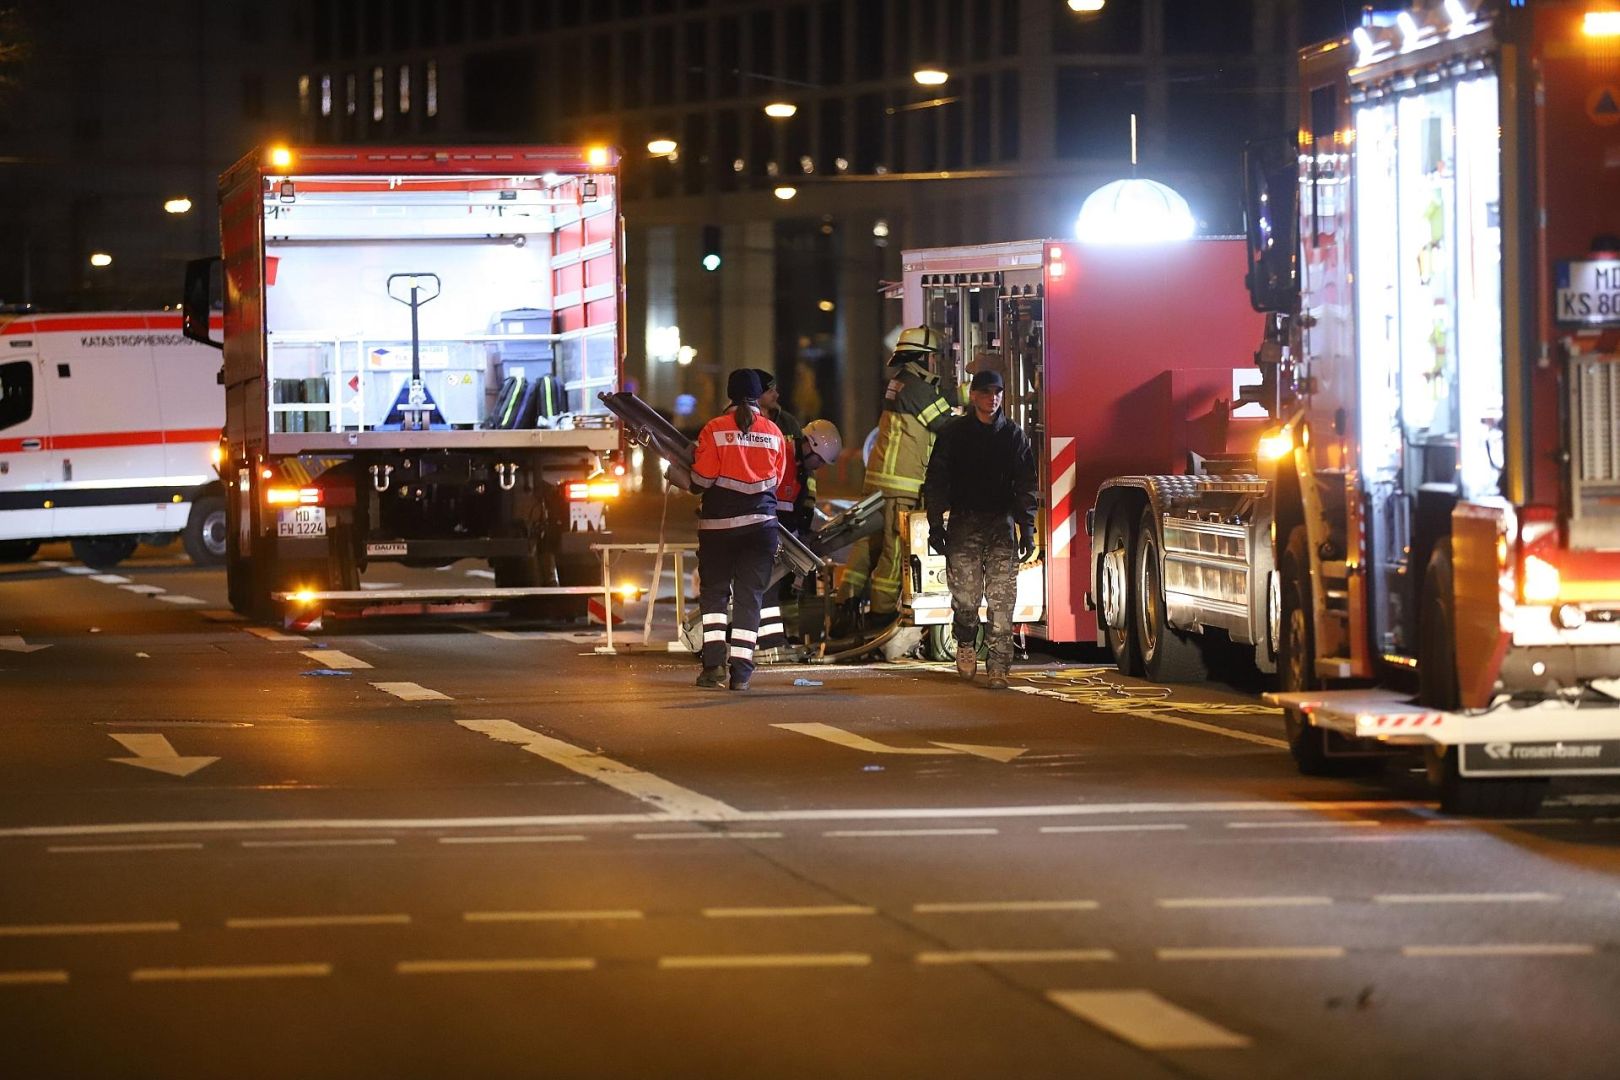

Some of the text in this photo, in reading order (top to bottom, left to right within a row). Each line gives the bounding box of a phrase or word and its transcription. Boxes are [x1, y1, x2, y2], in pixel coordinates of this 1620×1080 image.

[1563, 292, 1591, 316] KS
[737, 432, 773, 444] Malteser
[295, 510, 310, 522] MD
[280, 522, 324, 535] FW 1224
[1512, 742, 1602, 759] rosenbauer
